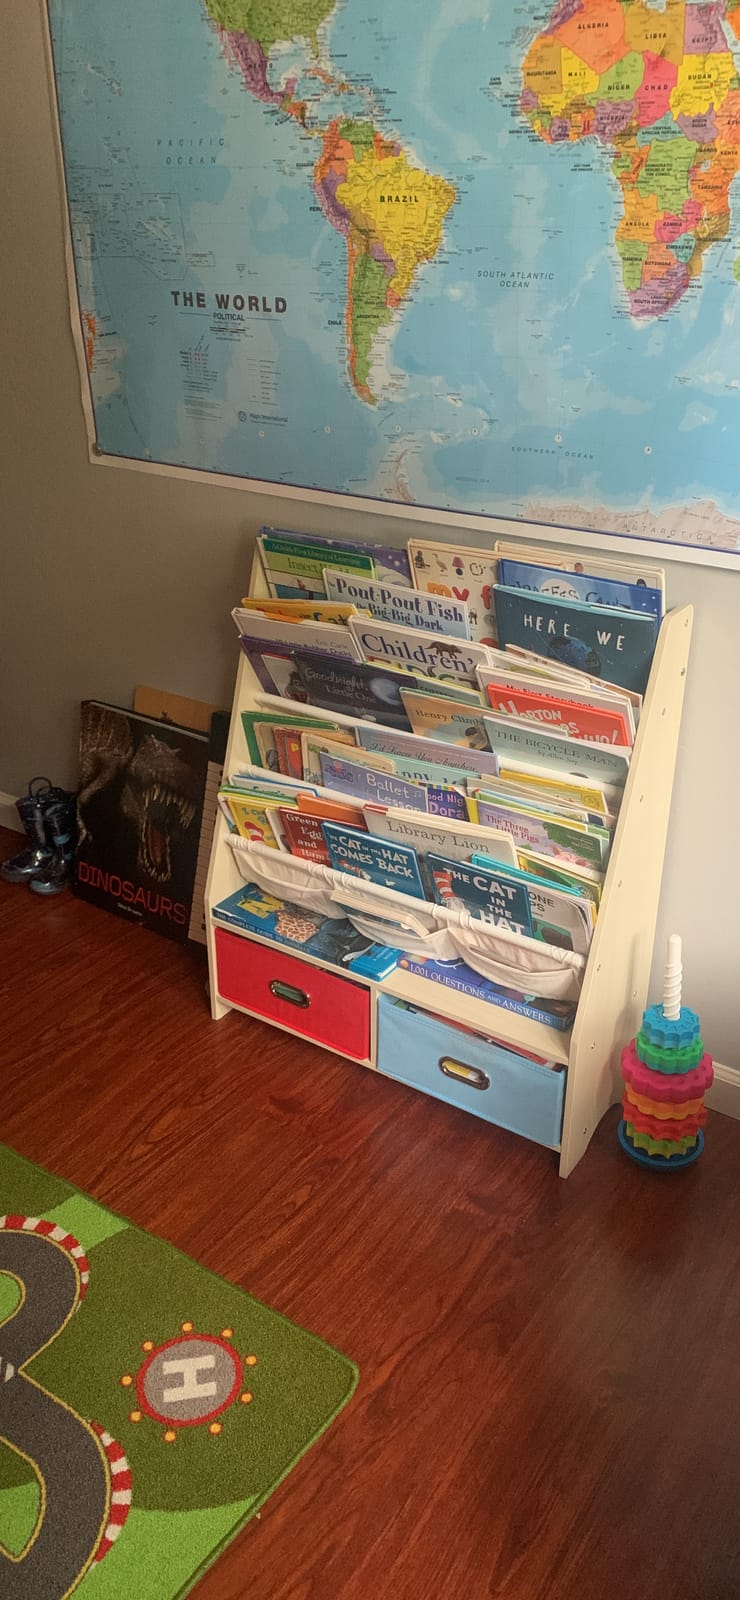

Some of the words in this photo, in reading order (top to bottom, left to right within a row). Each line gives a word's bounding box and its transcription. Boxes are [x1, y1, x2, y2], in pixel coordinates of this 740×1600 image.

[577, 22, 609, 30] ALGERIA
[157, 138, 225, 147] PACIFIC
[166, 156, 217, 165] OCEAN
[380, 195, 419, 203] BRAZIL
[477, 270, 506, 278] SOUTH
[510, 271, 554, 280] ATLANTIC
[499, 280, 530, 288] OCEAN
[170, 290, 206, 308] THE
[215, 293, 288, 313] WORLD
[212, 312, 245, 321] POLITICAL
[565, 451, 595, 459] OCEAN
[622, 523, 713, 541] ANTARCTICA
[287, 557, 319, 573] Insect
[336, 578, 422, 613] Pout-Pout
[427, 600, 464, 623] Fish
[368, 603, 414, 626] Big-Big
[415, 614, 444, 631] Dark
[523, 613, 570, 637] HERE
[596, 630, 625, 651] WE
[361, 633, 474, 673] Children'
[415, 709, 448, 722] Henry
[496, 730, 521, 743] THE
[525, 738, 581, 759] BICYCLE
[585, 754, 618, 768] MAN
[366, 773, 410, 799] Ballet
[427, 792, 443, 801] ood
[446, 794, 464, 806] Nig
[429, 801, 465, 819] Dora
[286, 813, 318, 827] Green
[485, 814, 503, 826] The
[504, 820, 529, 833] Three
[300, 826, 323, 840] Egg
[386, 820, 447, 844] Library
[452, 836, 490, 853] Lion
[496, 825, 519, 837] Little
[520, 832, 540, 844] Pigs
[297, 839, 317, 849] and
[339, 836, 361, 851] CAT
[381, 849, 408, 865] HAT
[300, 848, 325, 860] Ham
[330, 843, 374, 865] COMES
[376, 857, 414, 879] BACK
[443, 867, 470, 884] THE
[473, 875, 517, 900] CAT
[79, 861, 188, 925] DINOSAURS
[490, 895, 506, 908] IN
[486, 903, 513, 919] THE
[479, 909, 526, 936] HAT
[431, 971, 486, 999] QUESTIONS
[487, 994, 501, 1004] AND
[501, 1000, 551, 1024] ANSWERS
[162, 1354, 218, 1403] H
